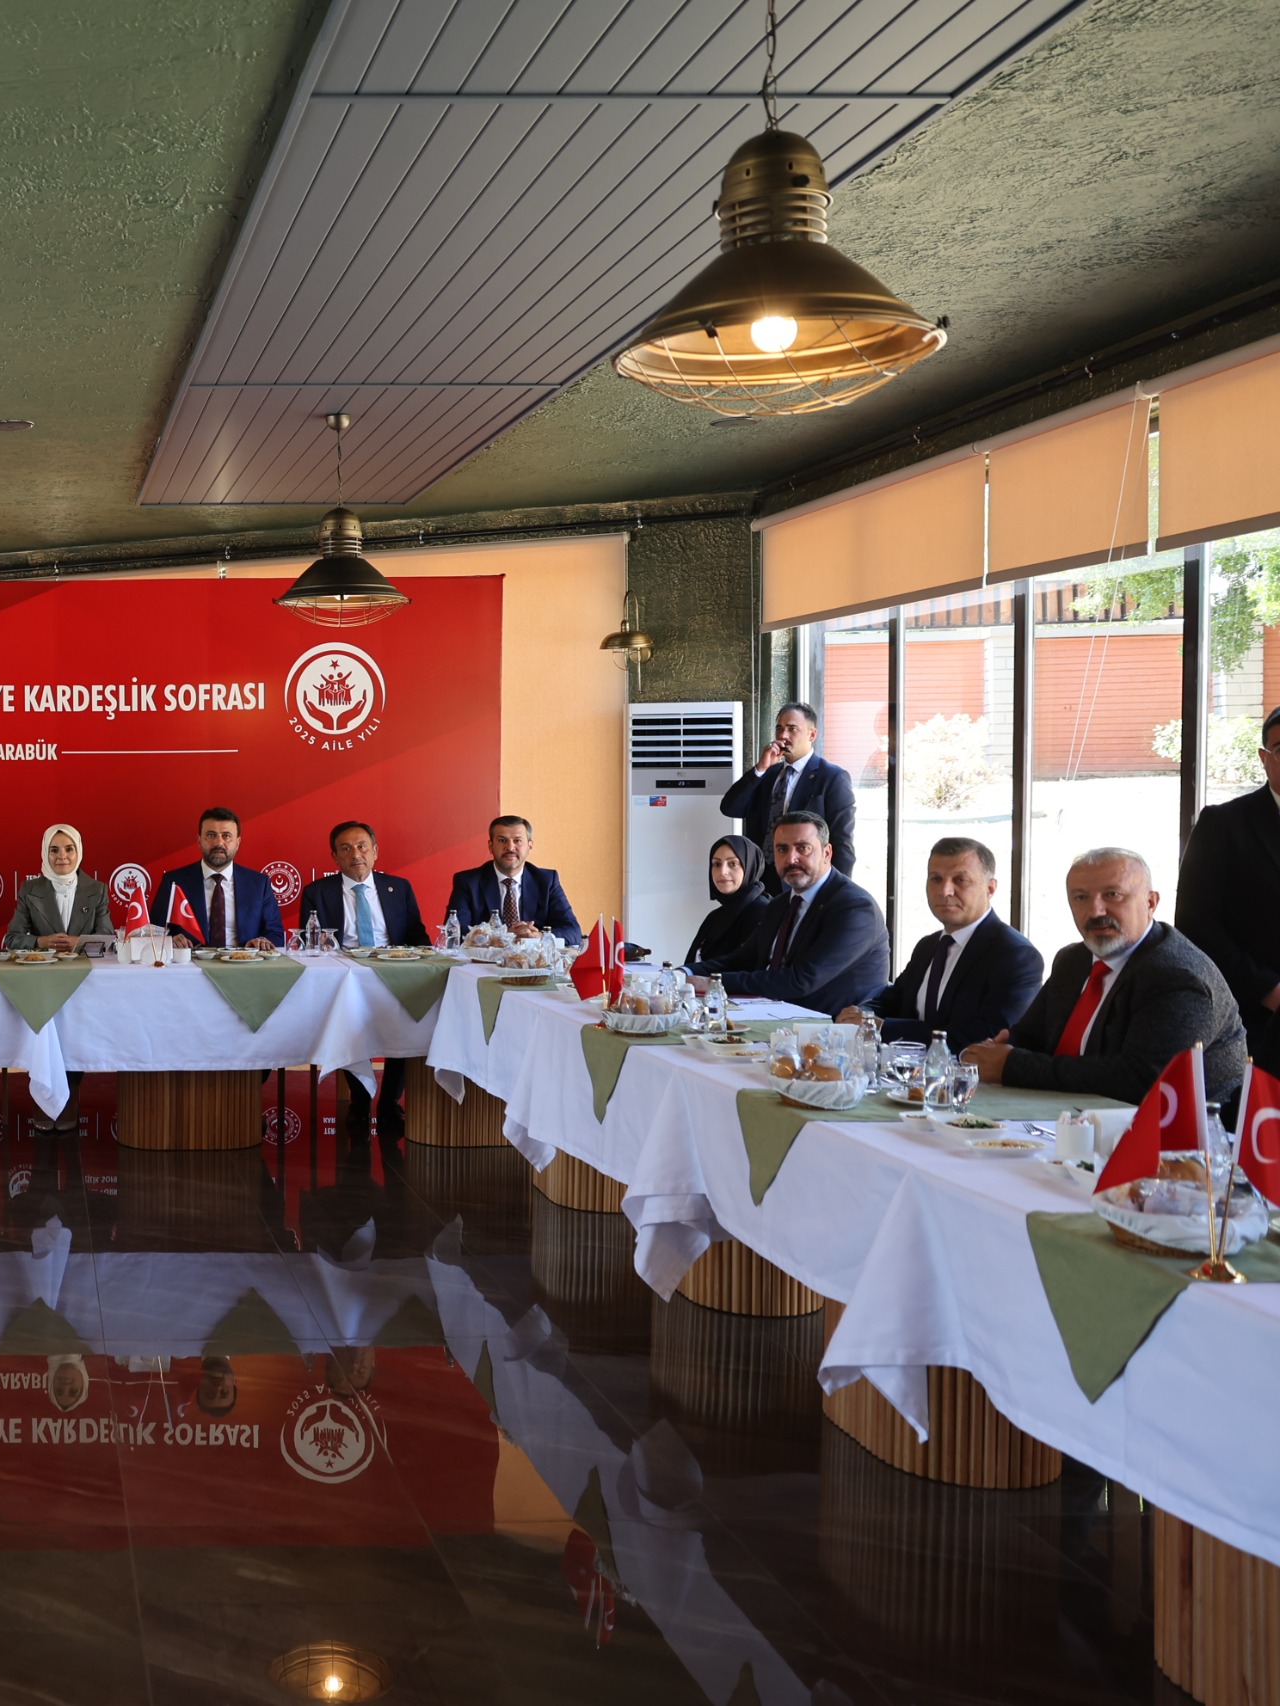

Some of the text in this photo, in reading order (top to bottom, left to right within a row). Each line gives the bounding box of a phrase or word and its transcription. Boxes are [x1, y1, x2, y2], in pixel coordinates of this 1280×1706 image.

[24, 677, 157, 720] KARDEŞLİK
[164, 682, 265, 712] SOFRASI
[289, 717, 381, 751] 2025 AİLE YILI
